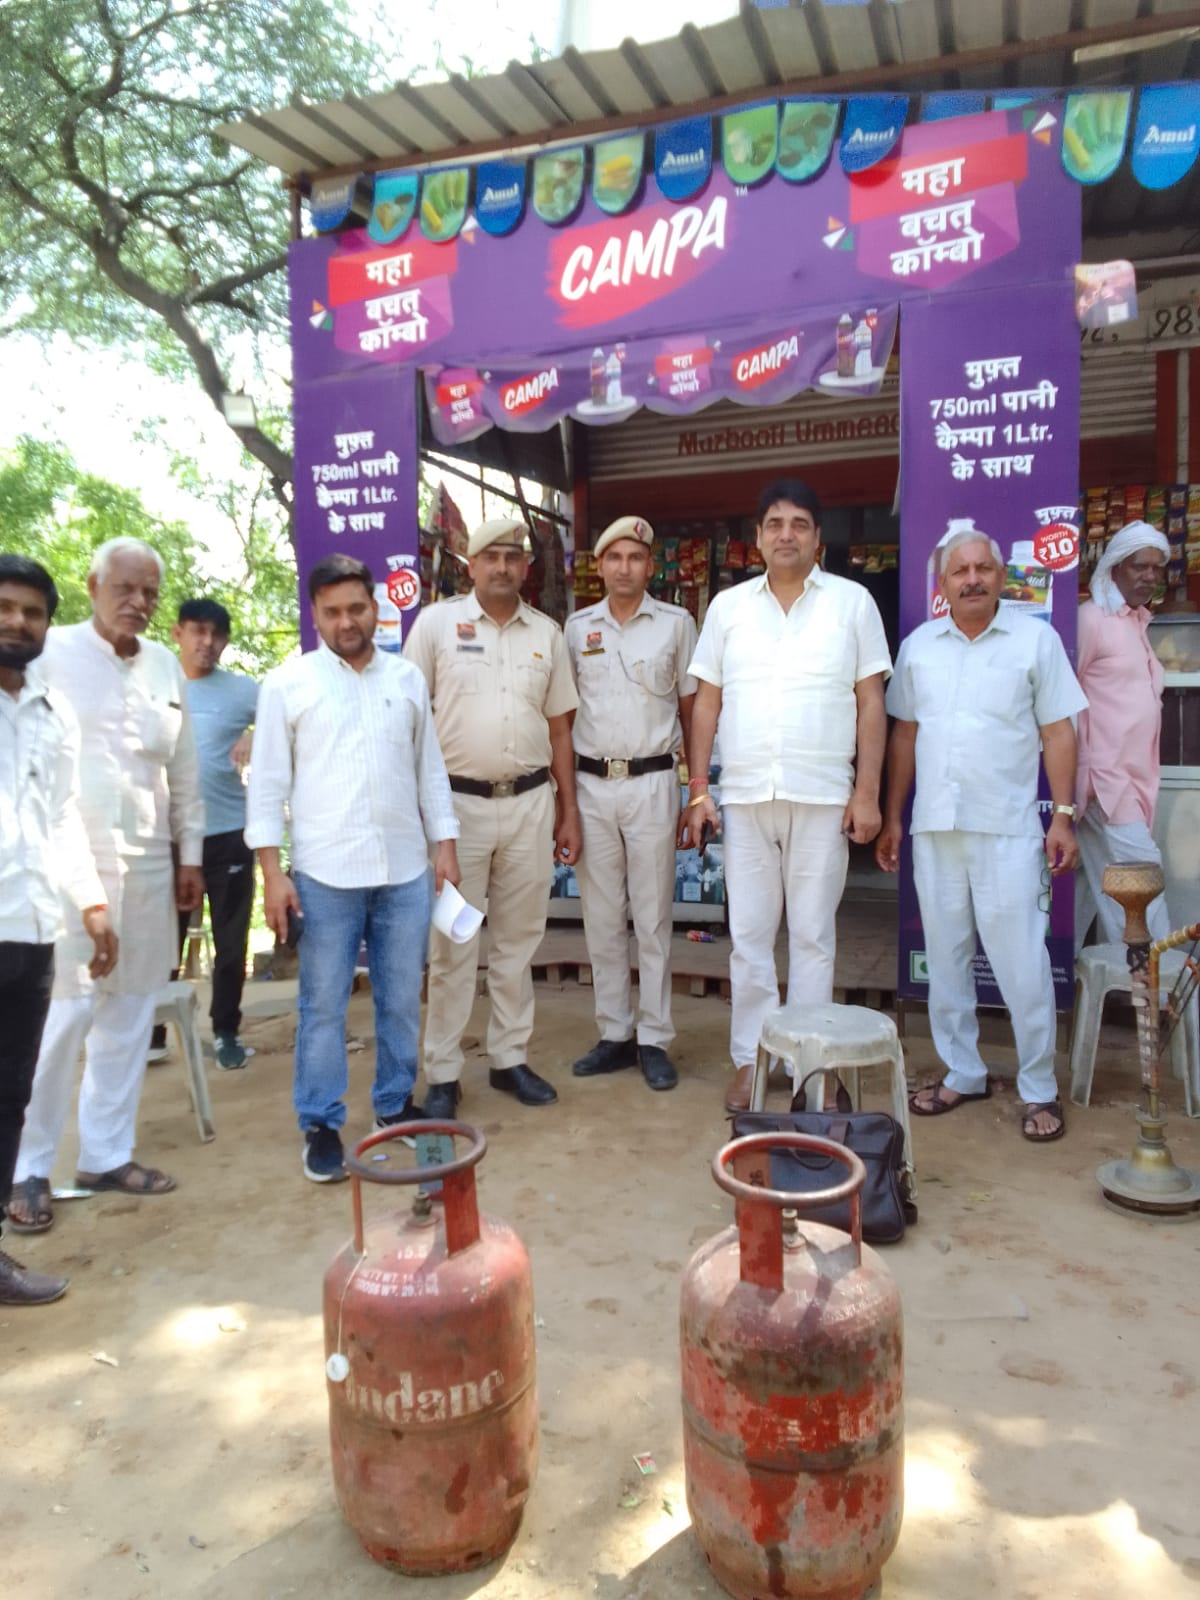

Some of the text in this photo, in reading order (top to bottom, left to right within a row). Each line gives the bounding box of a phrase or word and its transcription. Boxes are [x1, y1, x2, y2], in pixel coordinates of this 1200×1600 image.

[849, 126, 895, 143] Amul
[1143, 124, 1197, 145] Amul
[482, 182, 520, 202] Amul
[901, 157, 966, 196] महा
[899, 198, 976, 237] बचत
[560, 195, 728, 301] CAMPA
[889, 226, 985, 276] कॉम्बो
[365, 252, 413, 286] महा
[364, 288, 422, 320] बचत
[1153, 304, 1200, 338] 98
[358, 311, 429, 353] कॉम्बो
[736, 335, 799, 382] CAMPA
[504, 367, 559, 411] CAMPA
[929, 379, 1058, 420] 750ml पानी
[1003, 422, 1053, 445] 1Ltr.
[311, 449, 400, 483] 750ml पानी
[950, 452, 1034, 481] के साथ
[327, 509, 386, 535] के साथ
